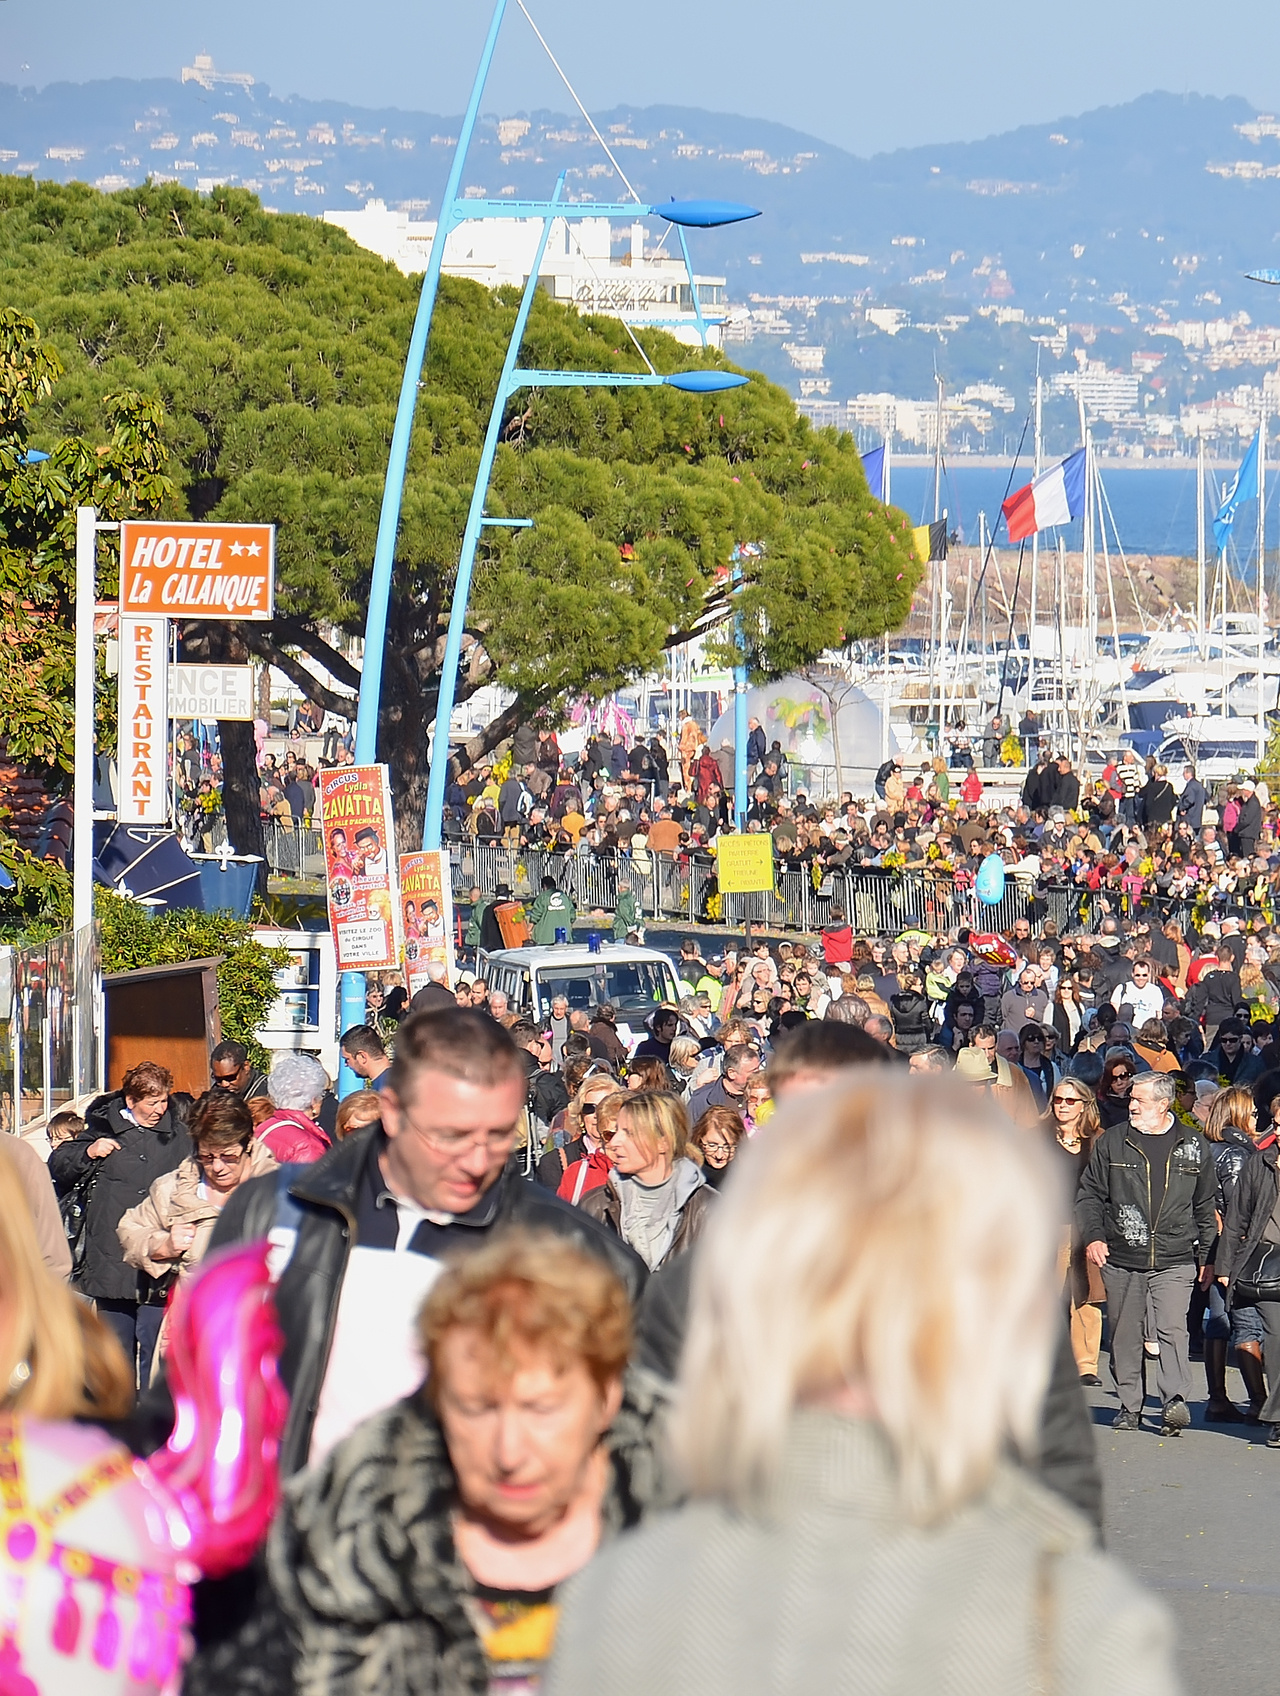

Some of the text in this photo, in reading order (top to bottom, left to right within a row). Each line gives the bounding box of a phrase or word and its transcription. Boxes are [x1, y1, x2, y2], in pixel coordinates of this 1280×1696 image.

[130, 536, 223, 569] HOTEL
[128, 573, 266, 612] La CALANQUE
[132, 625, 153, 816] RESTAURANT
[326, 773, 358, 794] CIRCUS
[344, 782, 368, 793] Lydia
[323, 794, 382, 821] ZAVATTA
[403, 858, 423, 873] CIRCUS
[402, 873, 440, 894] ZAVATTA
